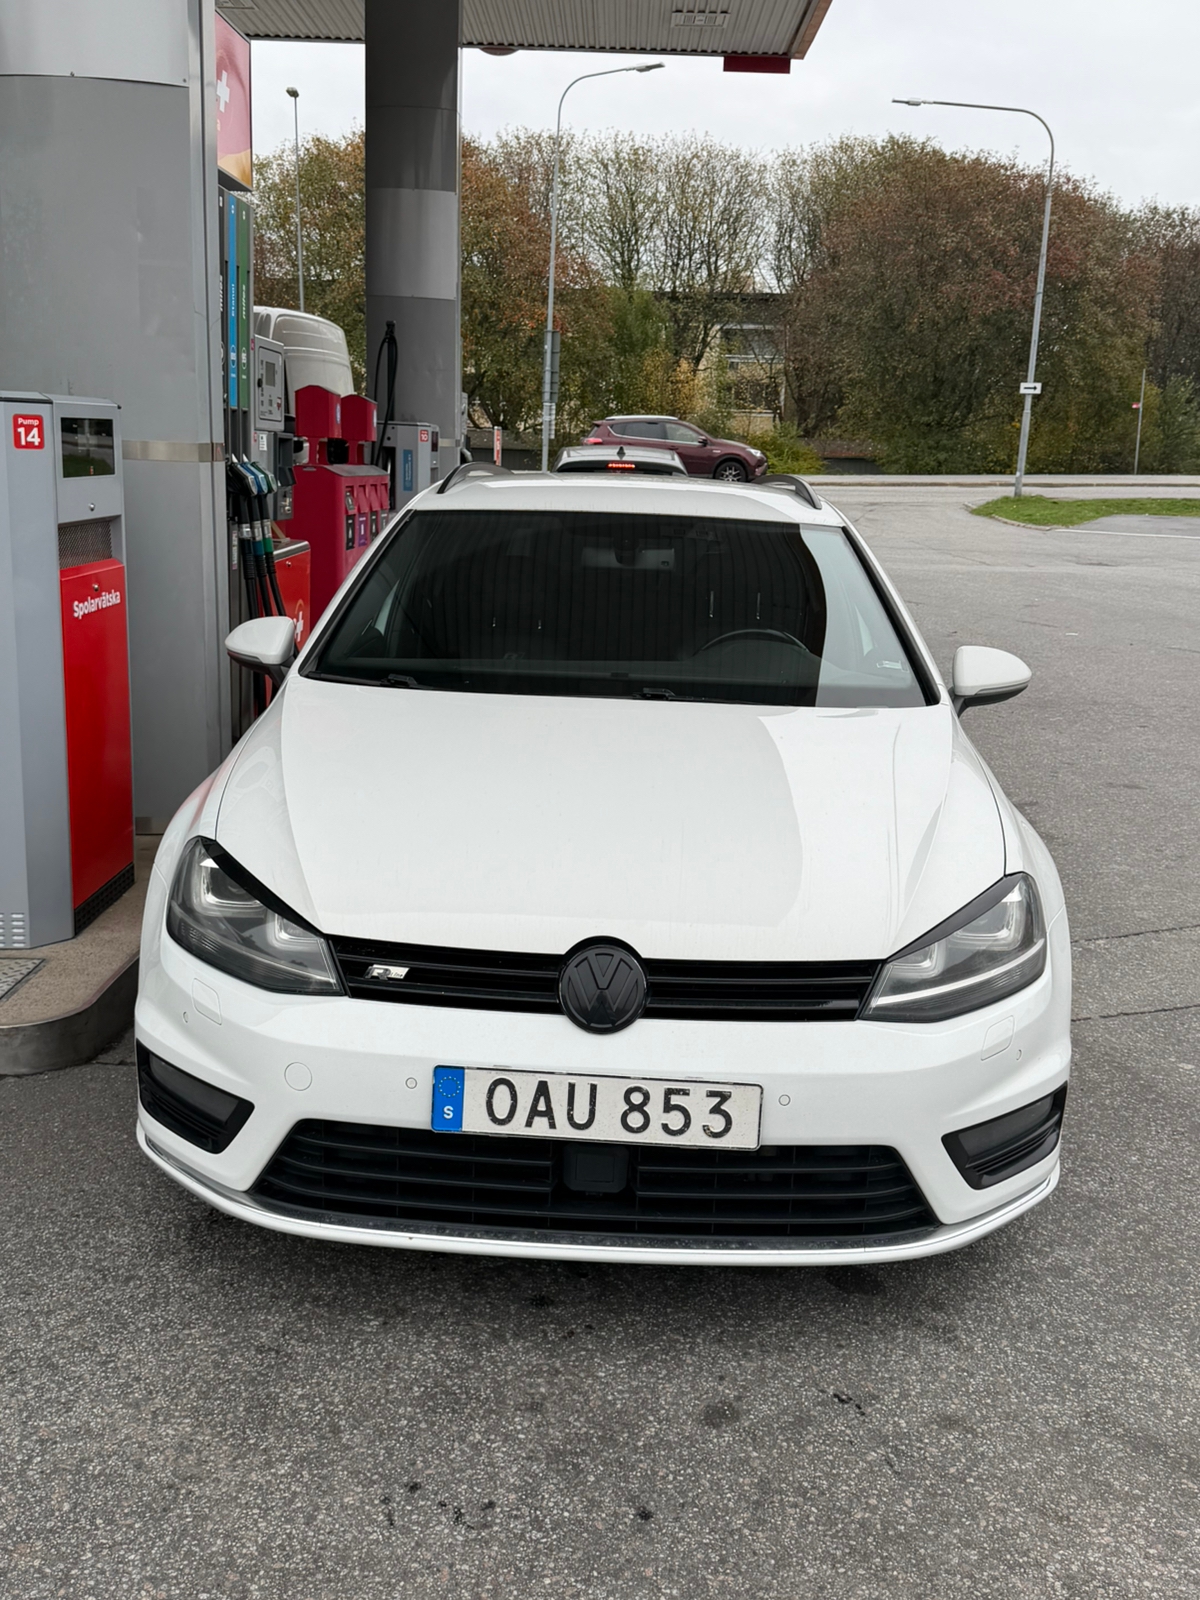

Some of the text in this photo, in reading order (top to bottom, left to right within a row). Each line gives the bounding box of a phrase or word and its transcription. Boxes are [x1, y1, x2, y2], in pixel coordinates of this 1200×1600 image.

[17, 417, 40, 427] Pump
[17, 427, 41, 446] 14
[73, 589, 121, 620] Spolarvätska
[443, 1105, 454, 1120] S
[485, 1077, 733, 1139] OAU 853
